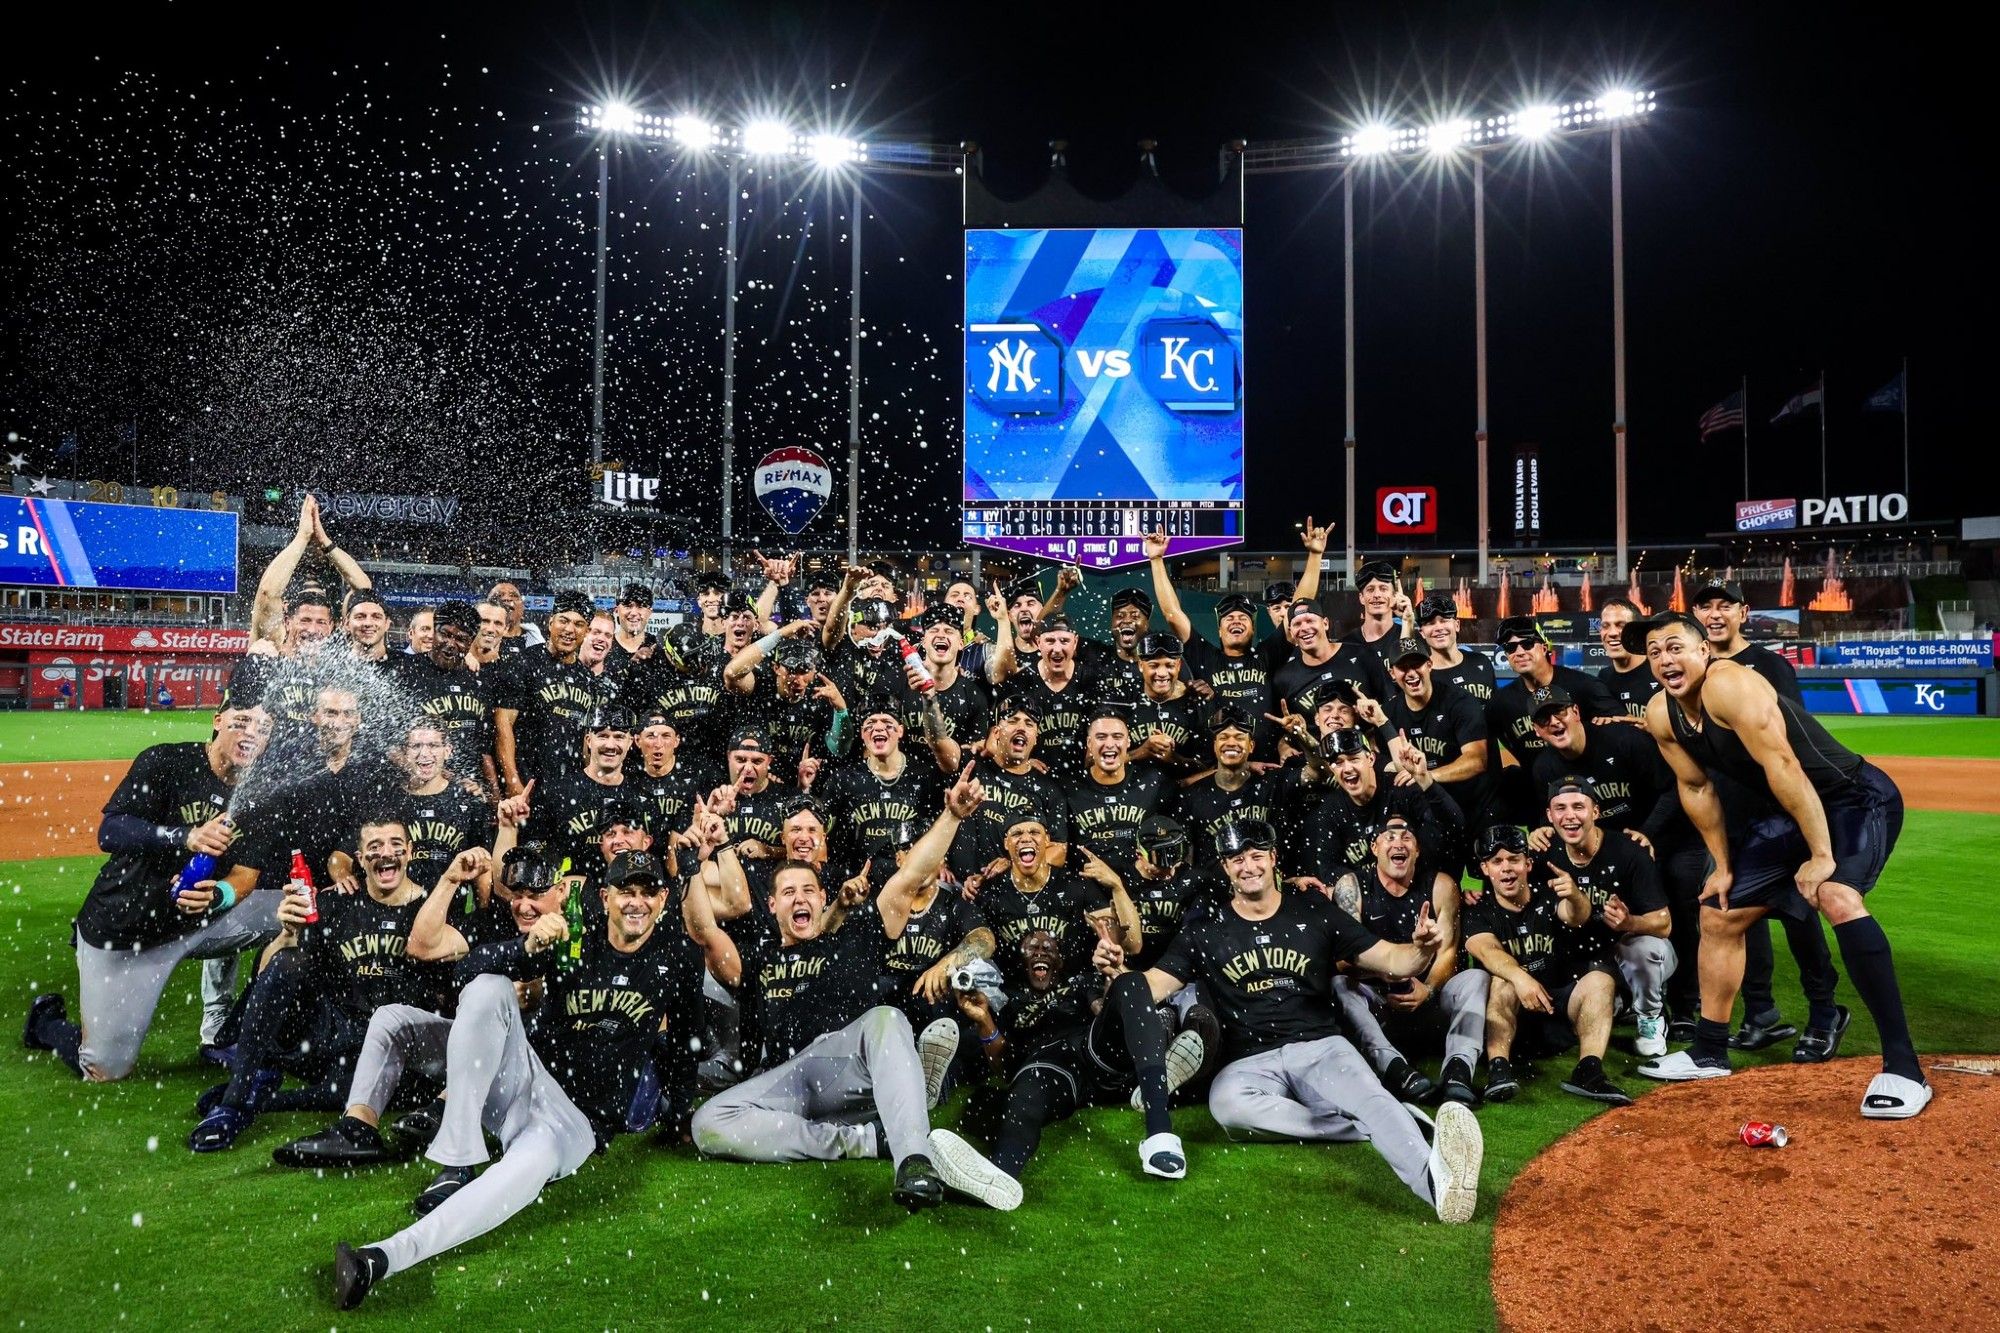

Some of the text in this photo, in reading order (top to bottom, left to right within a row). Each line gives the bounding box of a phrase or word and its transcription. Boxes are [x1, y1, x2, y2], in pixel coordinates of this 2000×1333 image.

[1160, 337, 1214, 392] KC
[764, 469, 822, 486] RE/MAX
[88, 480, 123, 503] 20
[150, 485, 178, 507] 10
[602, 470, 659, 507] Lite
[1515, 459, 1524, 530] BOULEVARD
[1531, 459, 1539, 529] BOULEVARD
[211, 490, 228, 511] 5
[1382, 492, 1426, 526] QT
[1739, 501, 1773, 517] PRICE
[1802, 493, 1908, 526] PATIO
[983, 510, 1190, 521] NYY 1 0 0 0 1 1 0 0 0 3 8 0 7 3
[1738, 509, 1794, 530] CHOPPER
[986, 524, 997, 535] KC
[1006, 524, 1011, 535] 0
[1019, 524, 1024, 535] 0
[1032, 524, 1038, 535] 0
[1046, 524, 1052, 535] 0
[1060, 524, 1065, 535] 0
[1087, 524, 1093, 535] 0
[1101, 524, 1106, 535] 0
[1113, 524, 1119, 535] 0
[1129, 524, 1133, 535] 1
[1143, 524, 1148, 535] 6
[1170, 524, 1176, 535] 4
[1184, 524, 1190, 535] 3
[1048, 543, 1065, 552] BALL
[1067, 539, 1077, 556] 0
[1083, 543, 1107, 552] STRIKE
[1108, 539, 1118, 556] 0
[1126, 543, 1139, 552] OUT
[0, 628, 104, 647] State Farm
[160, 632, 206, 648] State
[1840, 646, 1860, 655] Text
[1906, 646, 1917, 655] to
[1919, 644, 1990, 655] 816-6-ROYALS
[1937, 657, 1956, 665] Ticket
[1212, 669, 1267, 686] NEW YORK
[540, 682, 594, 709] NEW YORK
[658, 686, 719, 710] NEW YORK
[1222, 689, 1242, 697] ALCS
[1914, 684, 1945, 710] KC
[421, 695, 486, 716] NEW YORK
[553, 707, 571, 717] ALCS
[674, 709, 695, 718] ALCS
[1043, 738, 1062, 746] ALCS
[1131, 721, 1158, 742] NEW
[1416, 737, 1447, 756] YORK
[1525, 740, 1544, 748] ALCS
[852, 802, 881, 825] NEW
[983, 808, 1005, 822] ALCS
[1076, 805, 1147, 830] NEW YORK
[426, 821, 465, 849] YORK
[744, 816, 782, 844] YORK
[866, 827, 887, 836] ALCS
[1092, 830, 1115, 839] ALCS
[1345, 838, 1368, 864] NEW
[340, 936, 380, 963] NEW
[911, 936, 943, 958] YORK
[357, 965, 383, 977] ALCS
[759, 963, 787, 984] NEW
[1222, 948, 1312, 983] NEW YORK
[767, 987, 792, 999] ALCS
[1246, 978, 1295, 993] ALCS 2024
[565, 988, 654, 1024] NEW YORK
